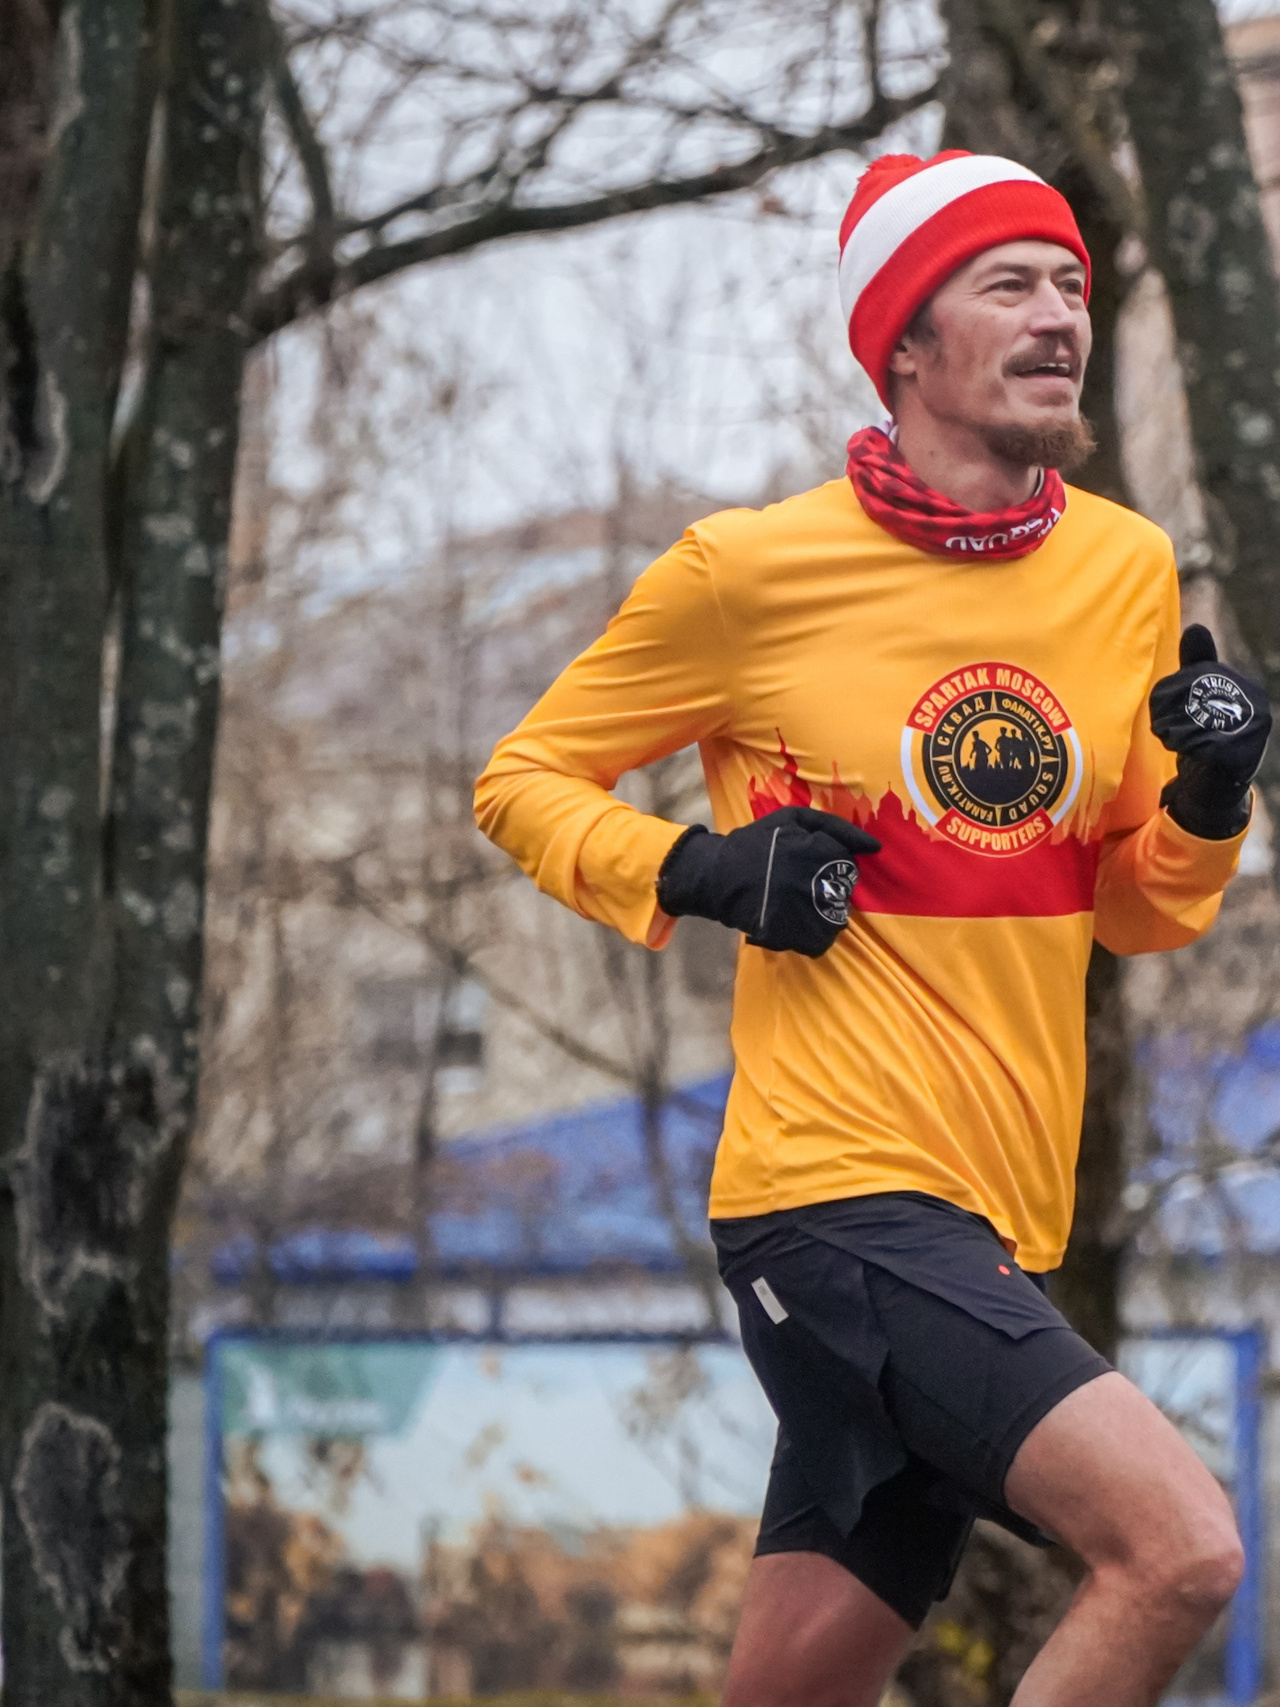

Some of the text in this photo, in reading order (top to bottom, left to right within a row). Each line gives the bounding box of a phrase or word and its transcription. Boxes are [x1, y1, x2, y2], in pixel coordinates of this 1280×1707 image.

[914, 667, 1067, 728] SPARTAK MOSCOW
[1201, 676, 1240, 697] TRUST
[937, 696, 985, 746] СКВАД
[1008, 771, 1054, 820] SQUAD
[946, 816, 1046, 851] SUPPORTERS
